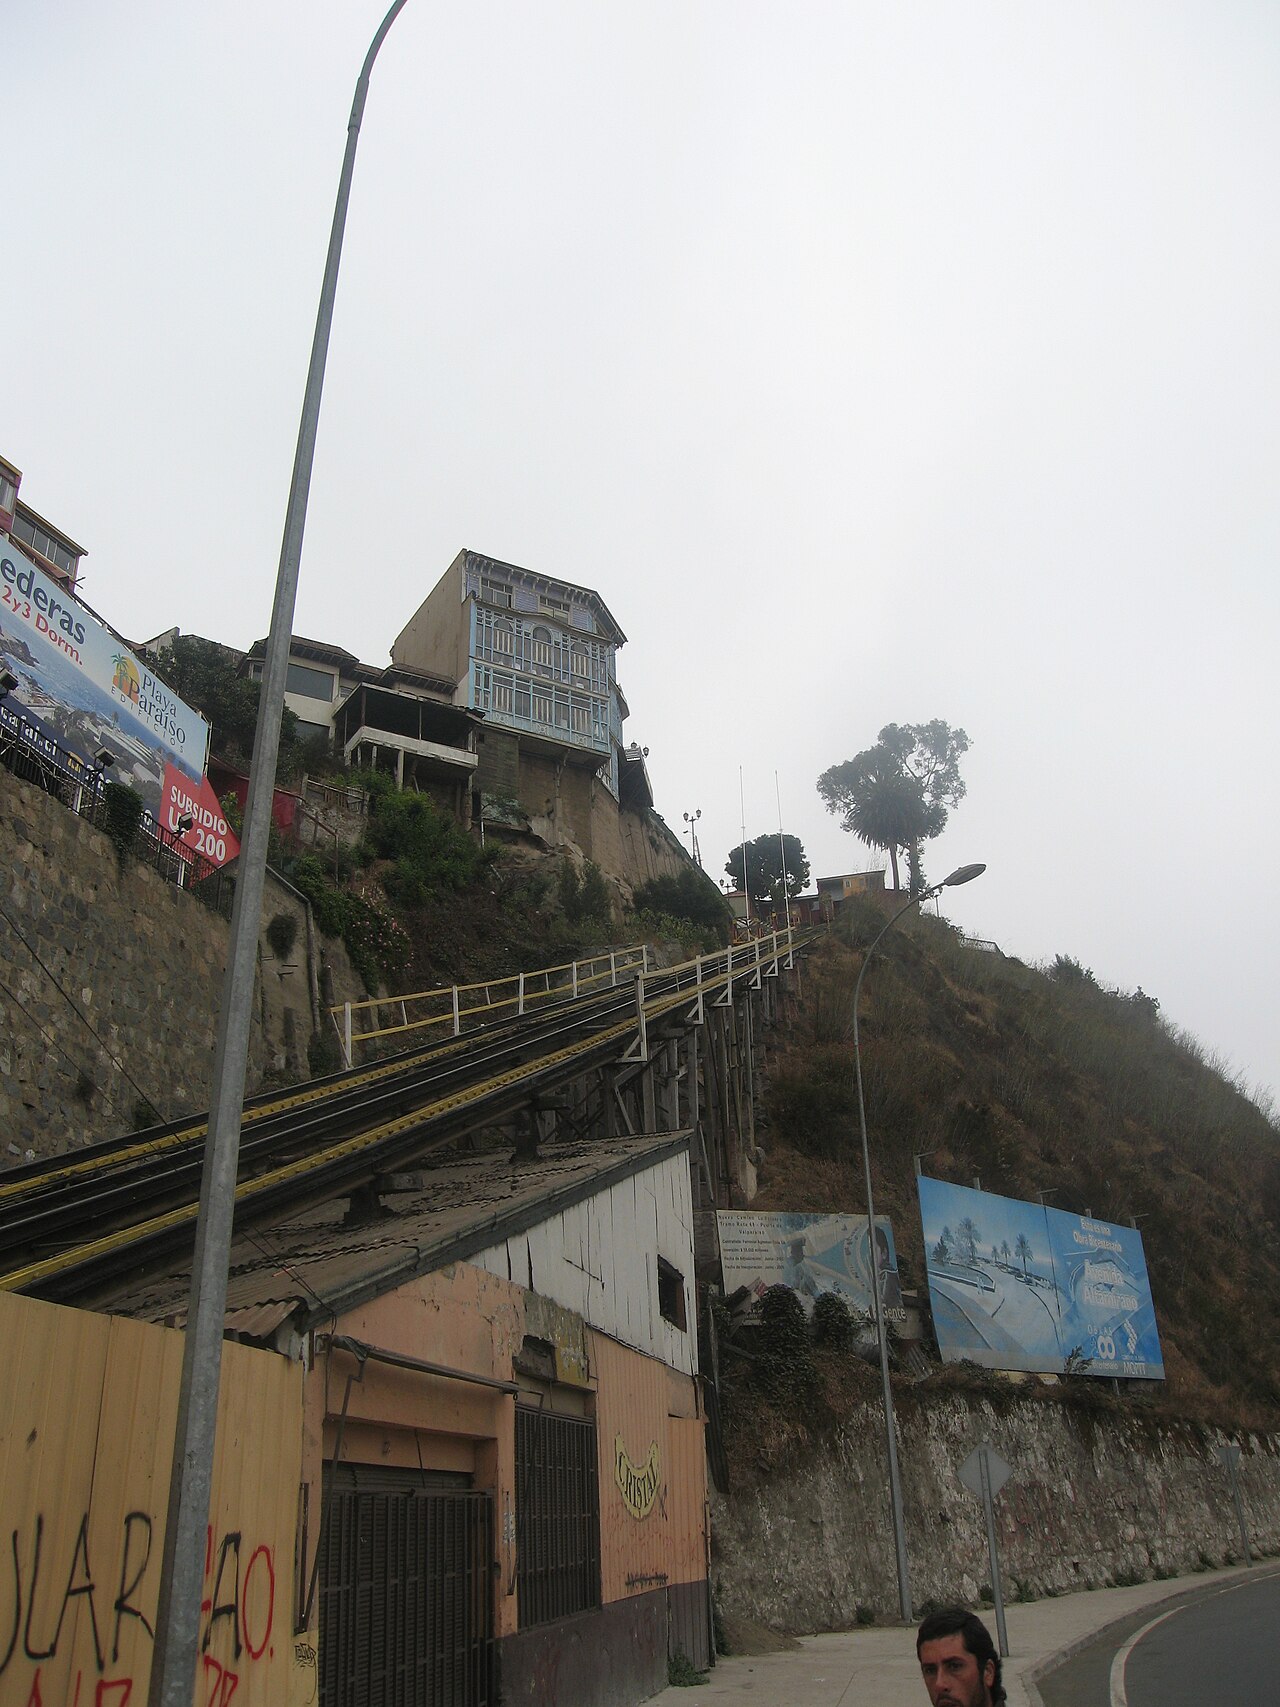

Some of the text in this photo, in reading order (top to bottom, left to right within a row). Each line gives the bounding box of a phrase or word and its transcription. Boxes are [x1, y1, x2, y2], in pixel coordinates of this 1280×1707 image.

[35, 612, 83, 666] Dorm.
[128, 677, 186, 744] Paraíso
[141, 672, 177, 718] Playa
[170, 785, 228, 836] SUBSIDIO
[195, 828, 226, 862] 200
[882, 1303, 907, 1319] Gente
